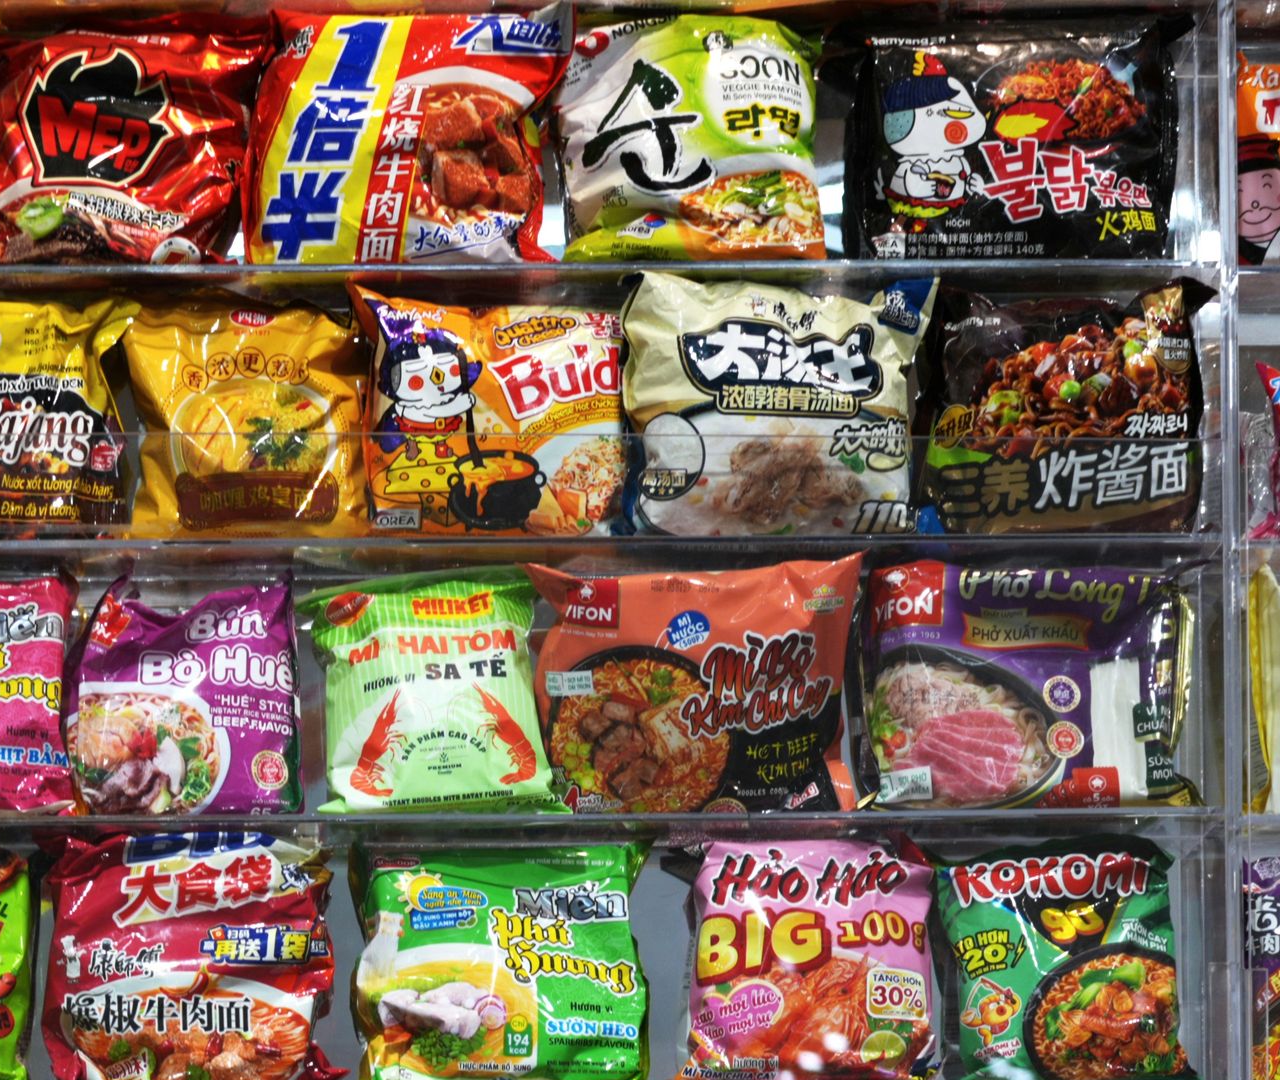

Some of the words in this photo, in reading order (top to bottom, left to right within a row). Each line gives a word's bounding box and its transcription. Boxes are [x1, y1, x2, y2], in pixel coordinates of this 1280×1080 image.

[191, 606, 266, 641] Bún
[671, 622, 706, 636] NƯỚC
[677, 612, 693, 627] MÌ
[455, 629, 516, 650] TÔM
[140, 653, 205, 685] Bò
[426, 662, 460, 680] SA
[470, 652, 507, 679] TẾ
[214, 716, 242, 728] BEEF
[698, 910, 824, 981] BIG
[841, 913, 903, 945] 100
[873, 987, 921, 1009] 30%
[548, 1021, 591, 1035] SƯỜN
[601, 1021, 637, 1038] HEO
[507, 1034, 529, 1046] 194
[509, 1046, 528, 1054] kcal
